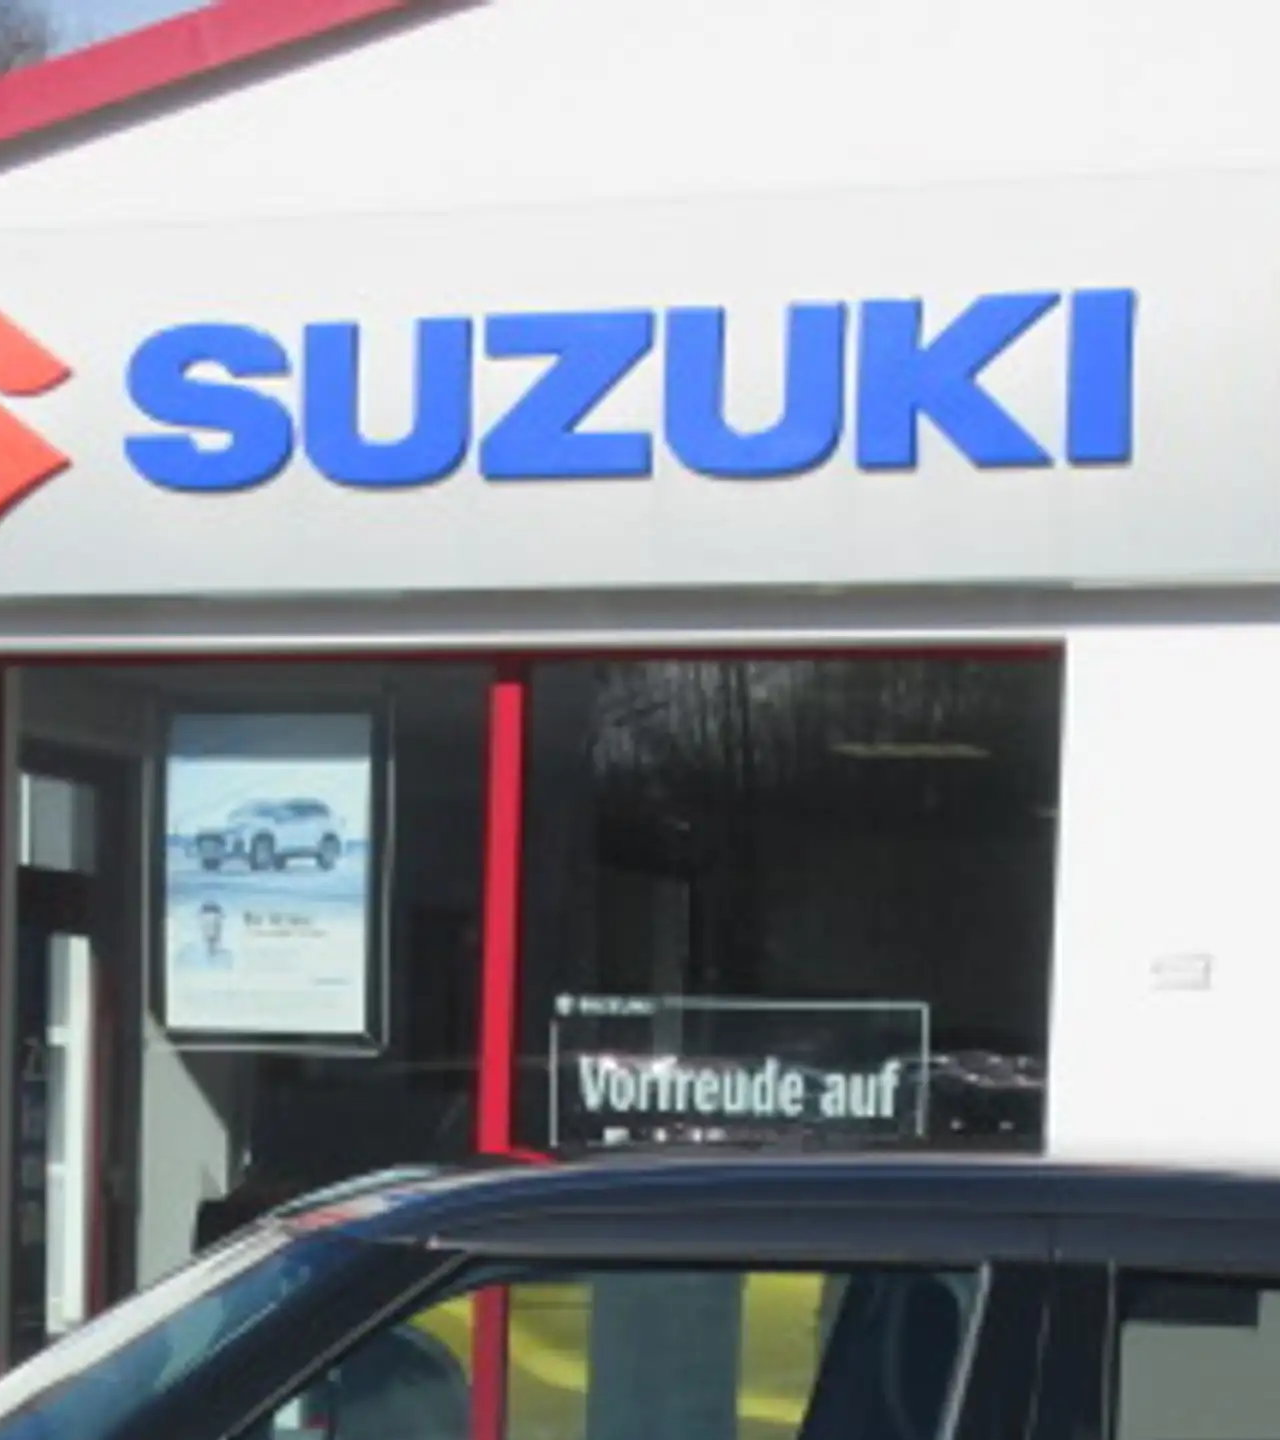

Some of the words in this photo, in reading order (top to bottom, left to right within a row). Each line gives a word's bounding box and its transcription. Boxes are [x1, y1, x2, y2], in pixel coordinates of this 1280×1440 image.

[122, 287, 1136, 494] SUZUKI
[578, 1053, 804, 1116] Vorfreude
[820, 1057, 902, 1119] auf
